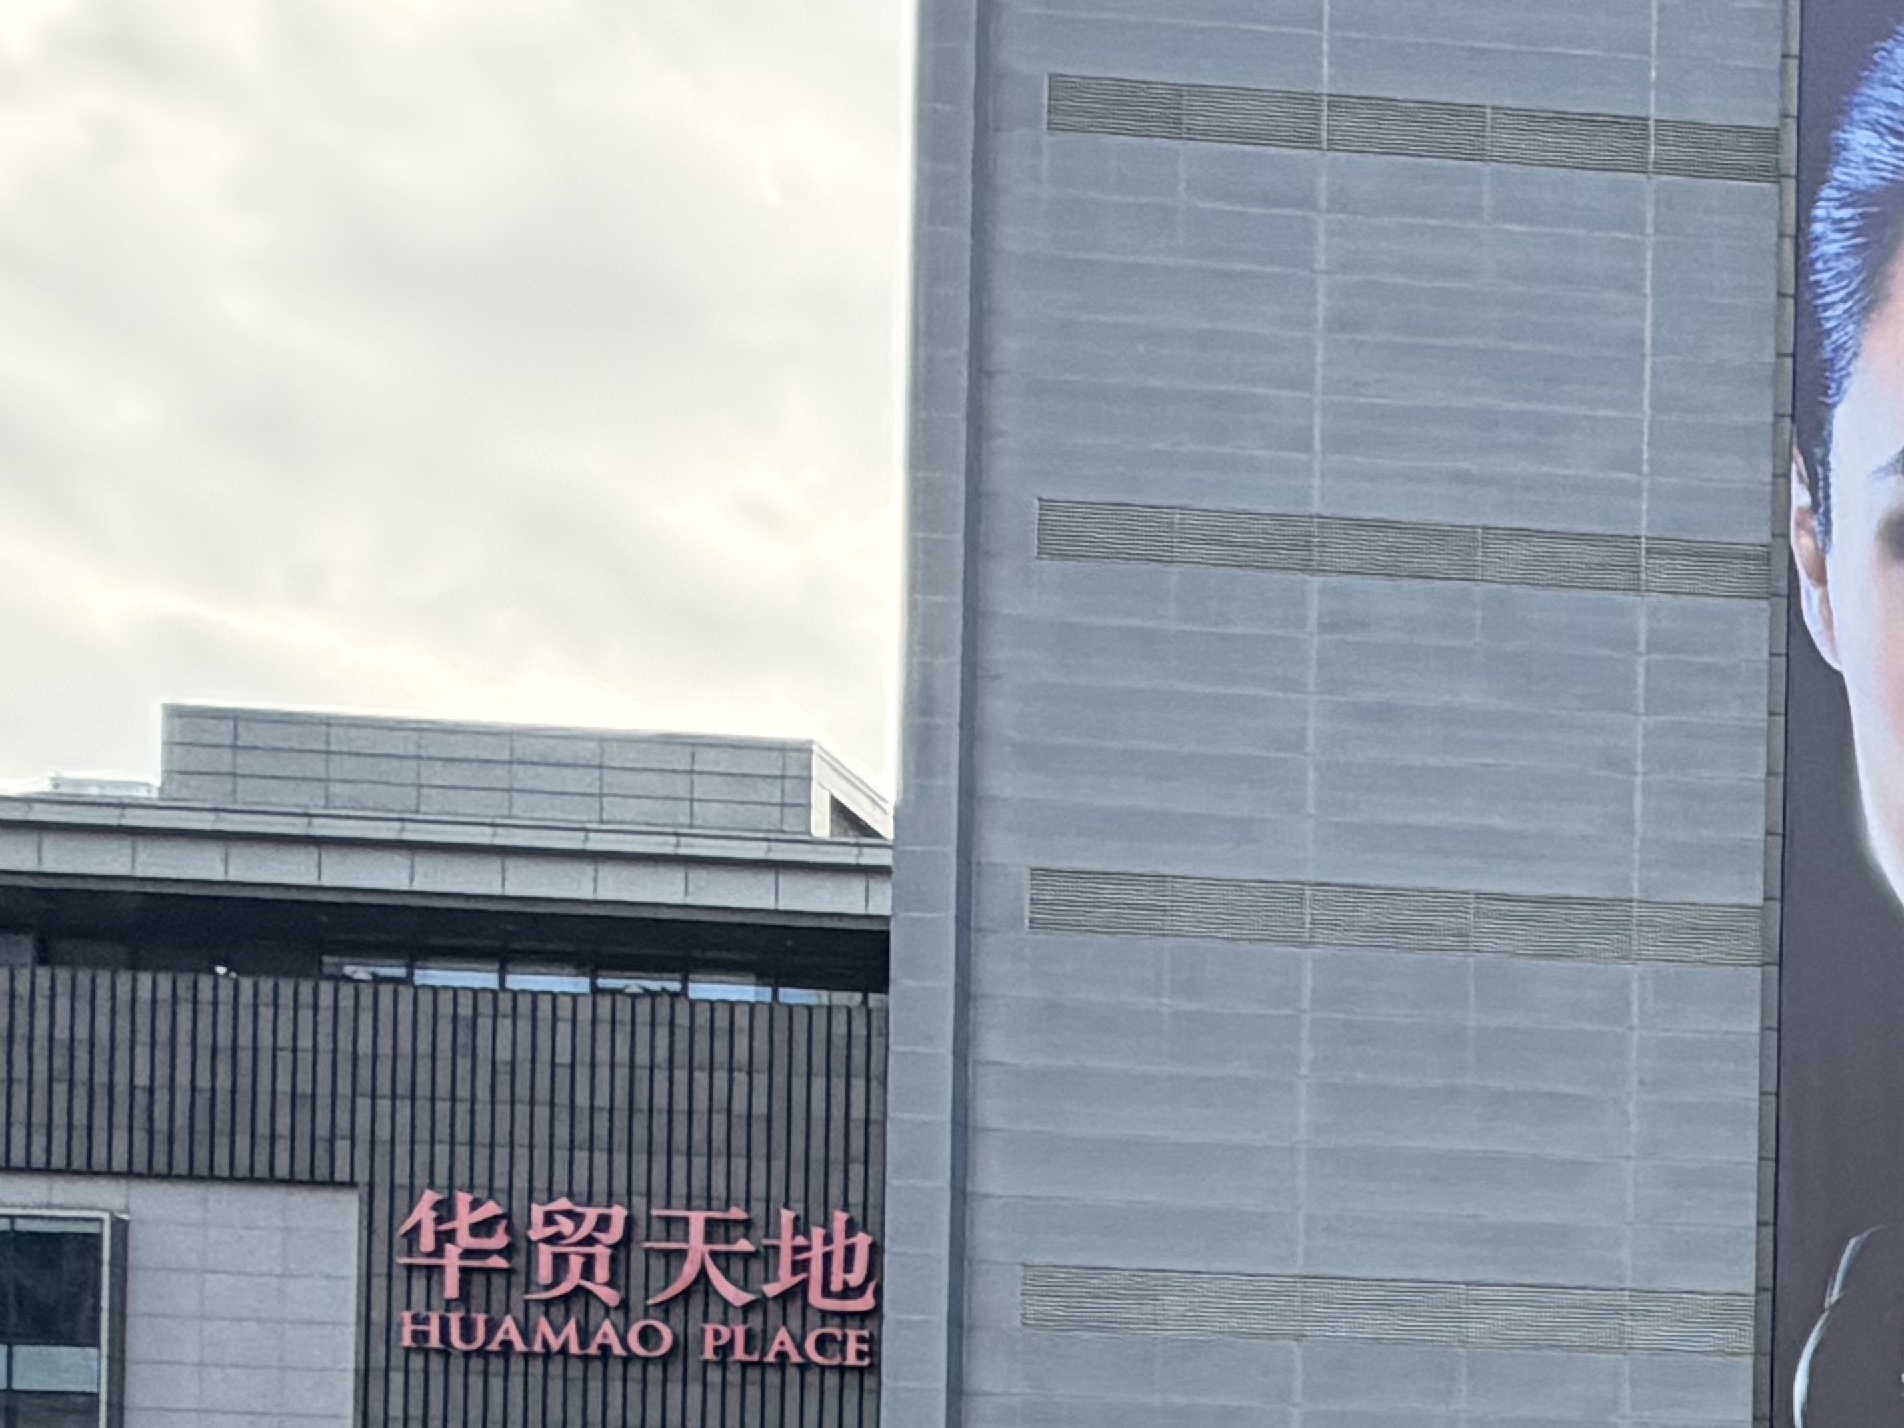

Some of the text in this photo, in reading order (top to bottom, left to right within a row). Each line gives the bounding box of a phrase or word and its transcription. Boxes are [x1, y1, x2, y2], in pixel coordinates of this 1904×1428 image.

[395, 1188, 878, 1312] 华贸天地
[400, 1311, 873, 1367] HUAMAO PLACE
